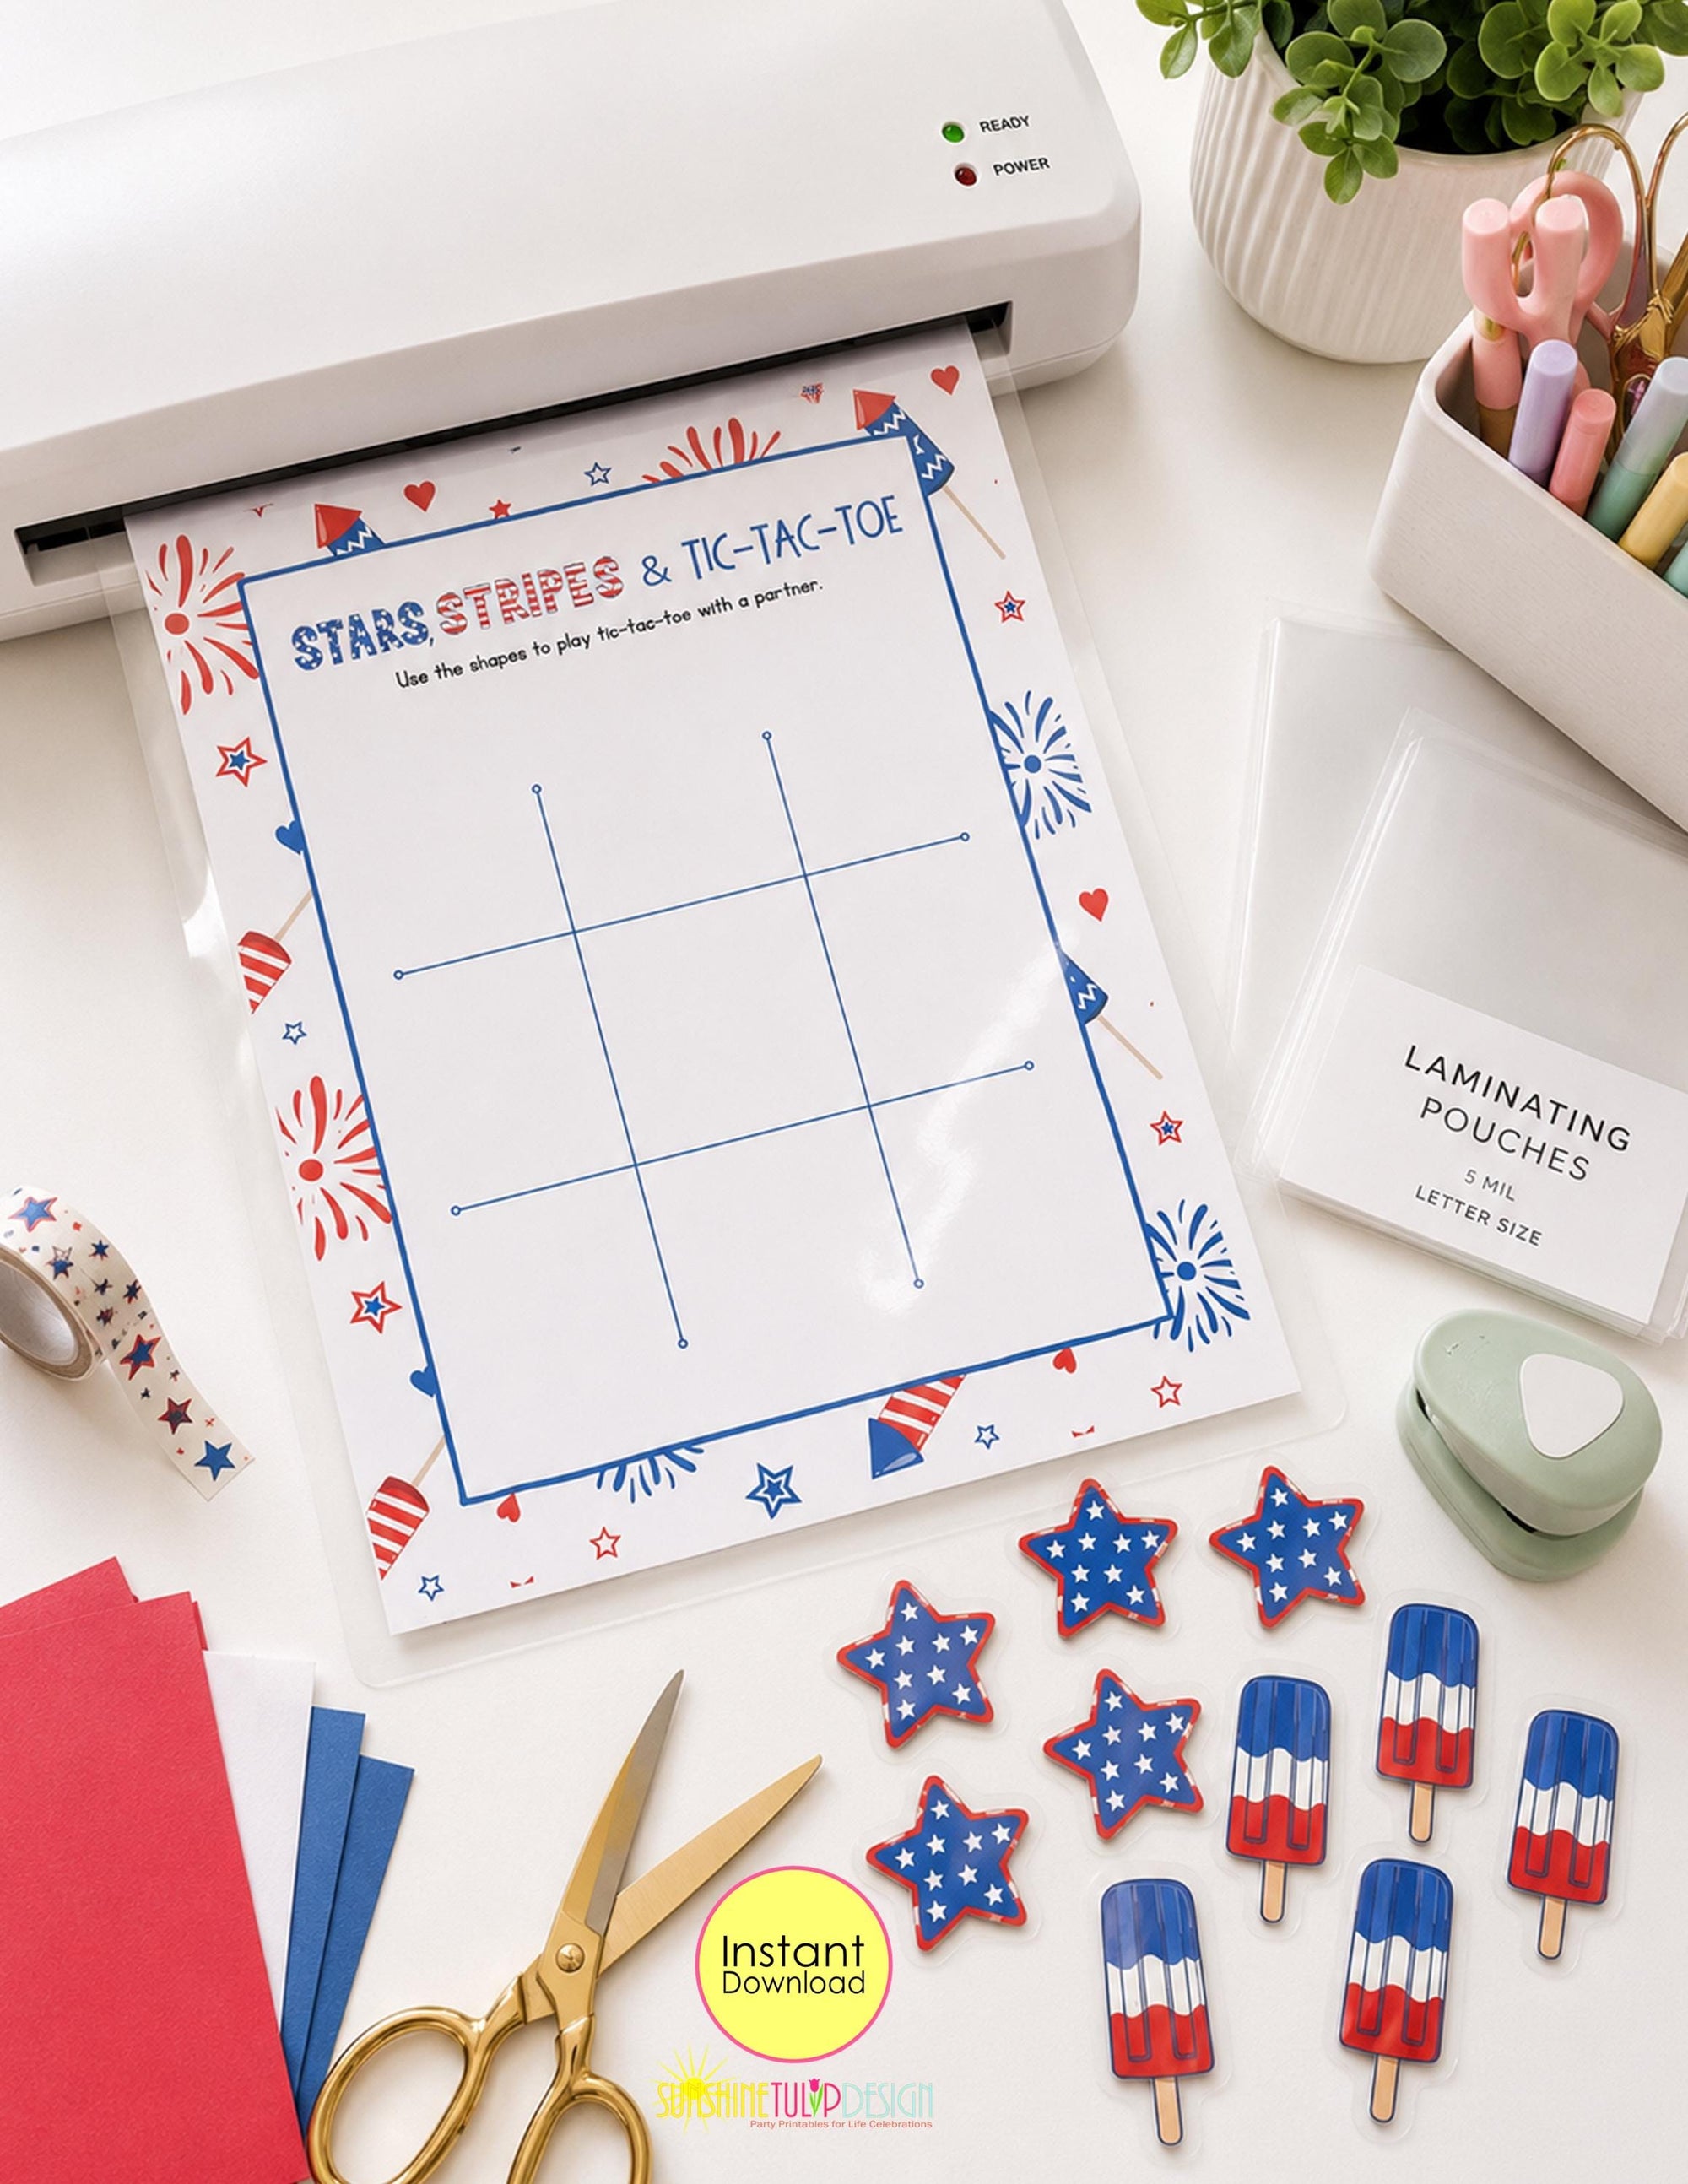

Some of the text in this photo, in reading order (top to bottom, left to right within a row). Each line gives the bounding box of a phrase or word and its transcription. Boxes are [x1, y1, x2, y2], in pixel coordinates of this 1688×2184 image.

[979, 116, 1029, 132] READY
[993, 157, 1050, 176] POWER
[436, 556, 624, 635] STRIPES
[641, 555, 672, 586] &
[680, 495, 903, 580] TIC-TAC-TOE
[395, 578, 824, 689] Use the shapes to play tic-tac-toe with a partner.
[1404, 1045, 1631, 1152] LAMINATING
[1420, 1096, 1589, 1181] POUCHES
[1415, 1185, 1542, 1247] LETTER SIZE
[1463, 1169, 1516, 1202] 5 MIL
